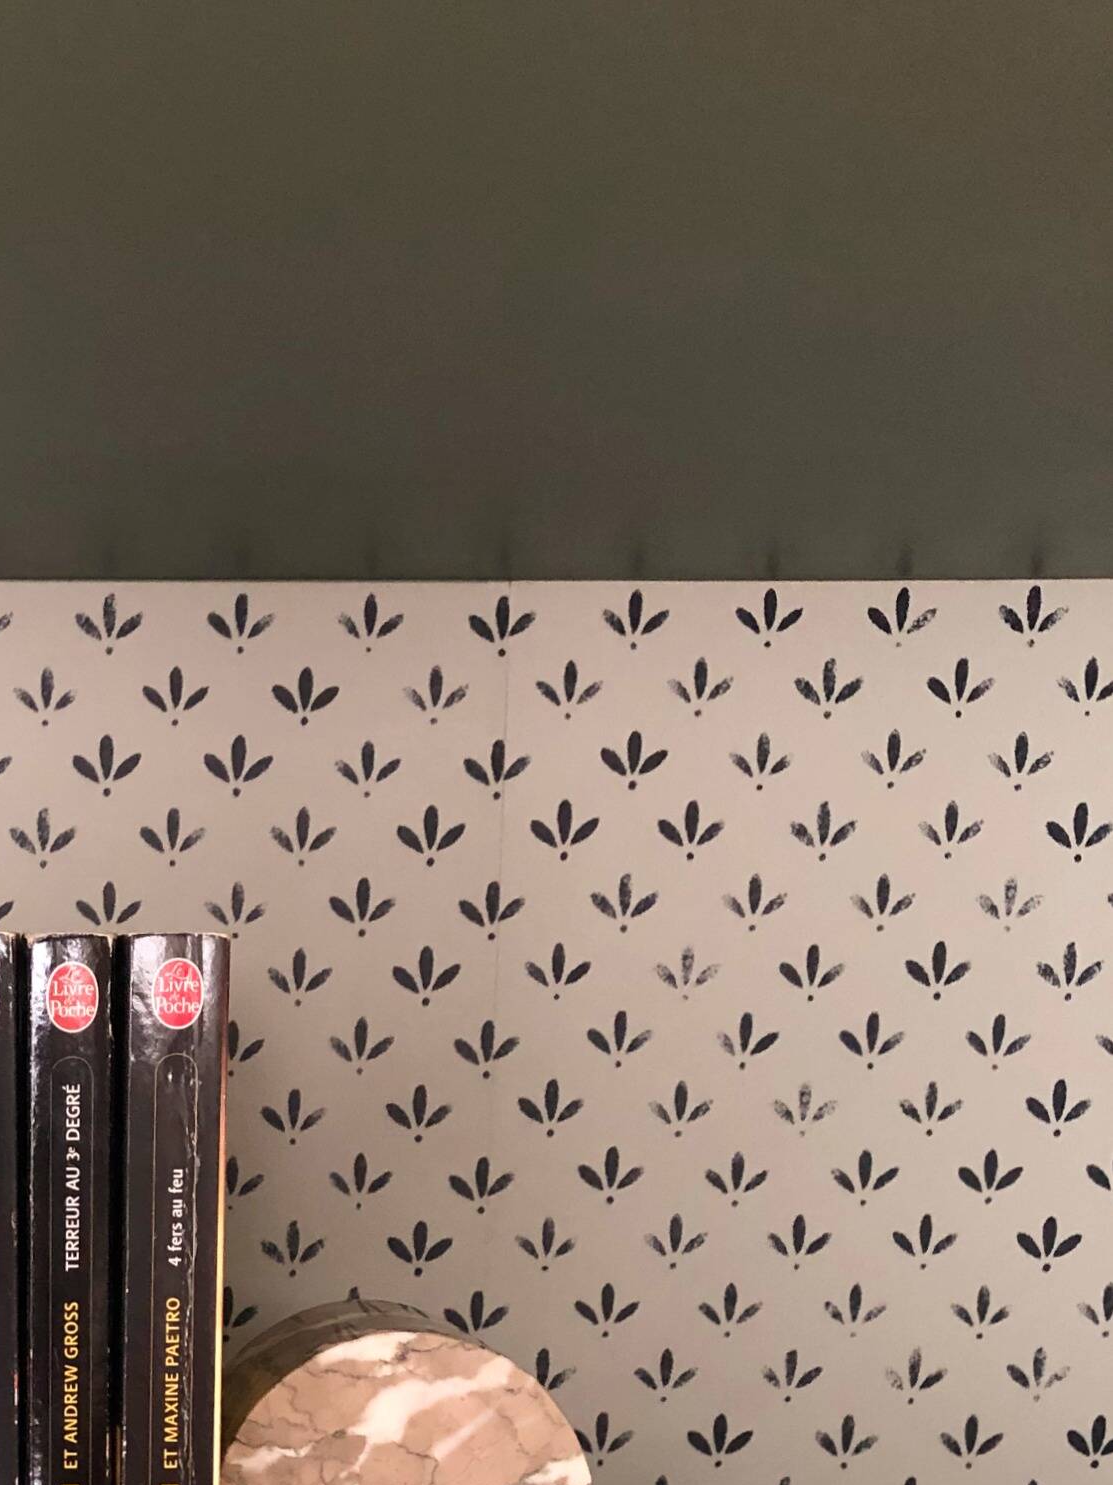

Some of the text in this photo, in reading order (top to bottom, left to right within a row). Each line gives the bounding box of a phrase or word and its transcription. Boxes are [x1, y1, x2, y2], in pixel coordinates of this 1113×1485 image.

[52, 981, 94, 996] Livre
[156, 996, 200, 1014] Poche
[158, 976, 199, 993] Livre
[50, 1000, 95, 1018] Poche
[61, 1083, 81, 1142] DEGRÉ
[64, 1166, 81, 1191] AU
[65, 1196, 81, 1272] TERREUR
[167, 1168, 184, 1267] 4 fers au feu
[64, 1301, 79, 1359] GROSS
[165, 1297, 181, 1368] PAETRO
[63, 1364, 79, 1444] ANDREW
[164, 1371, 180, 1444] MAXINE
[63, 1448, 79, 1470] ET
[163, 1448, 179, 1470] ET
